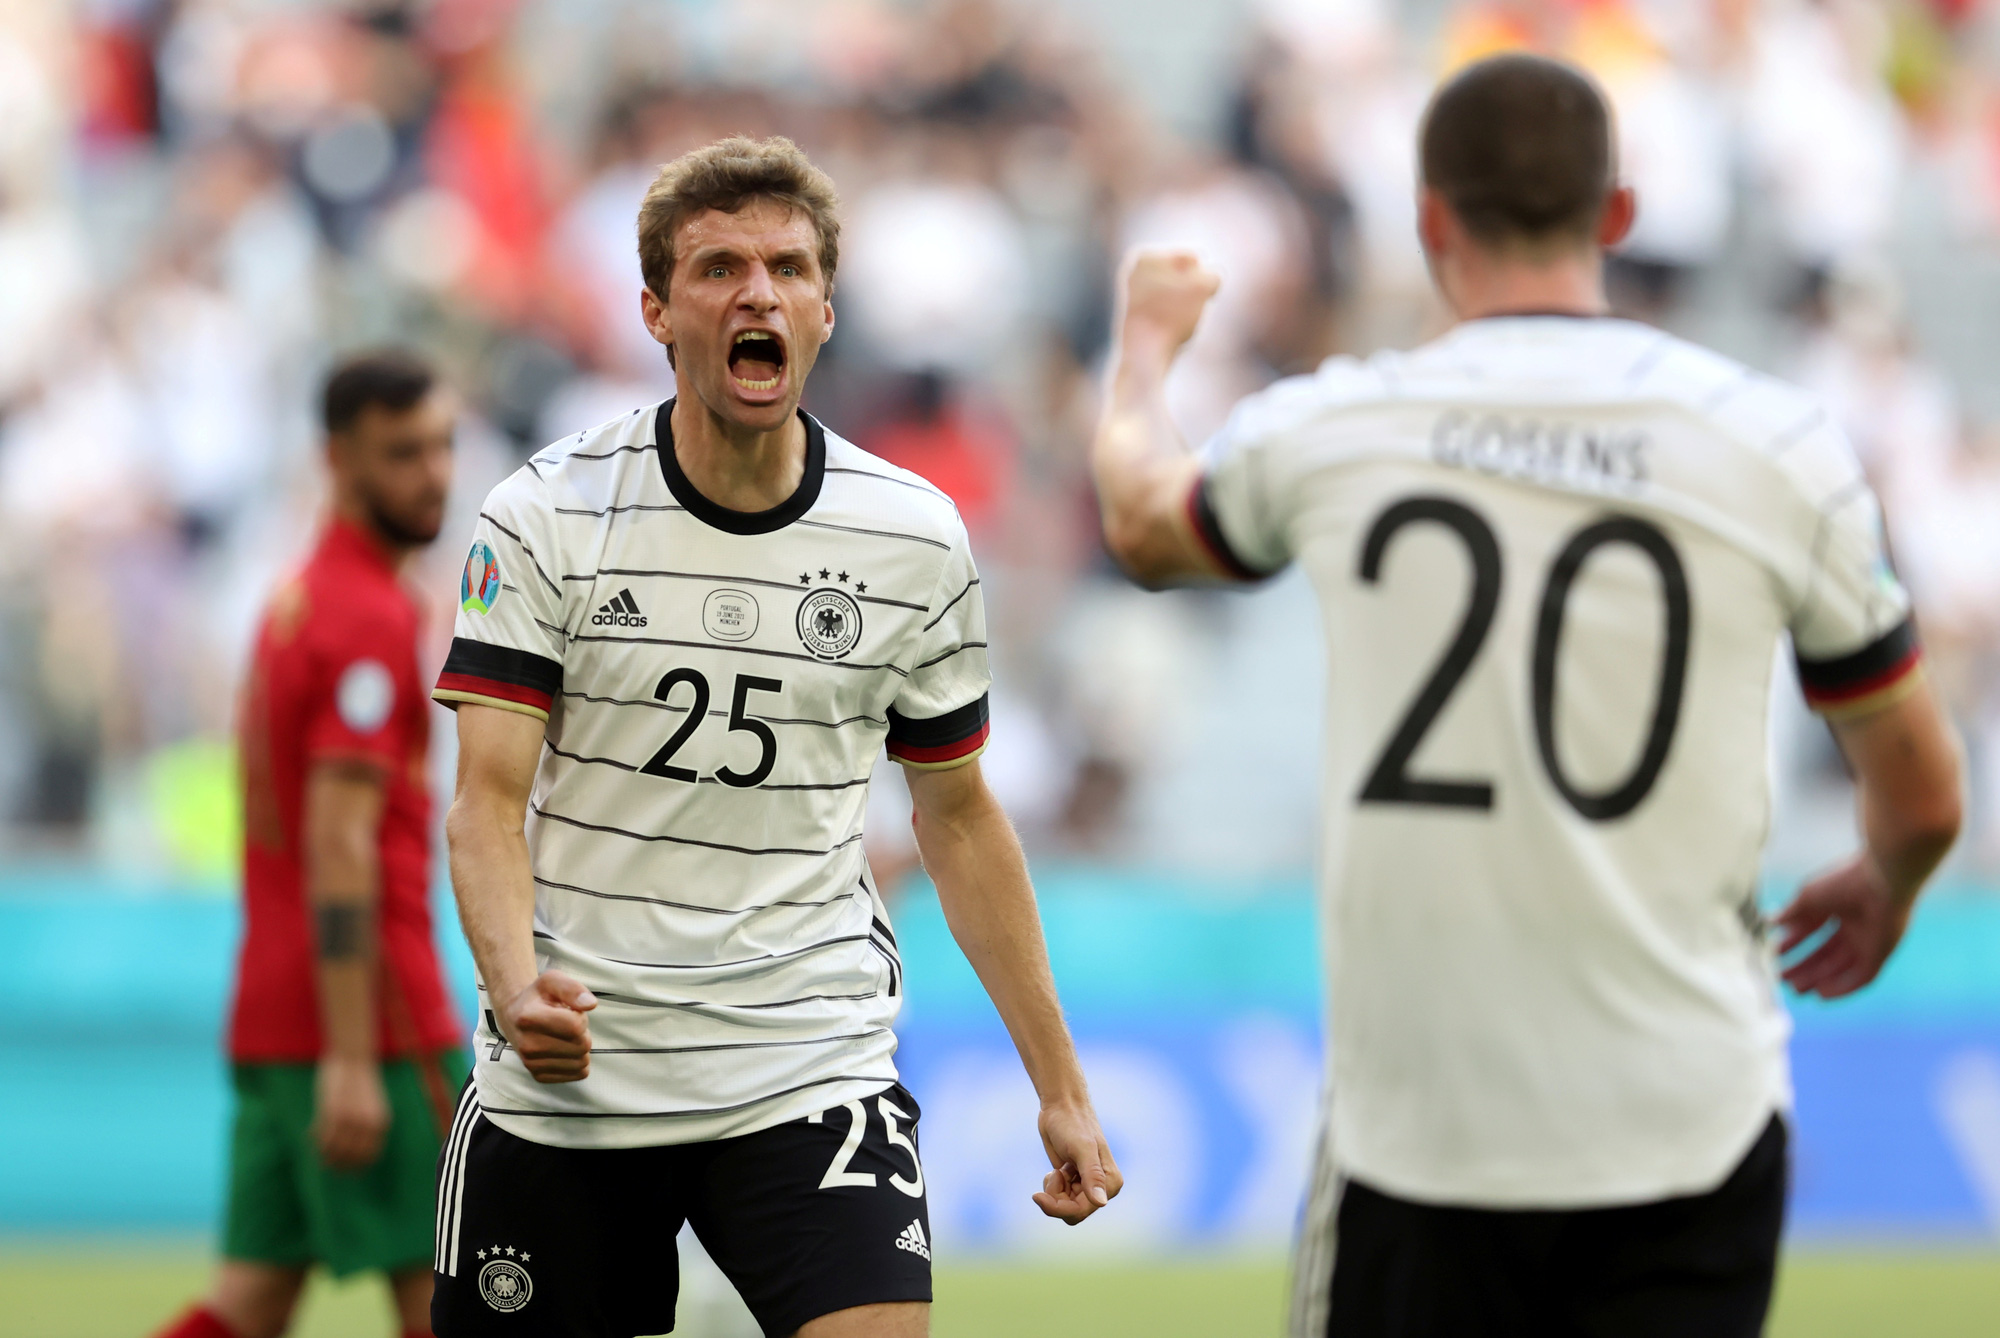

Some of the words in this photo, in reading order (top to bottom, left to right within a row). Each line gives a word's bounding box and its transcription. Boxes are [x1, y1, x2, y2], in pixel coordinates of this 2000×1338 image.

[1430, 411, 1654, 485] GOSENS
[591, 611, 648, 627] adidas
[720, 604, 742, 612] PORTUGAL
[811, 596, 850, 613] DEUTSCHER
[1355, 496, 1691, 825] 20
[638, 667, 783, 788] 25
[807, 1095, 924, 1199] 25
[488, 1266, 519, 1277] DEUTSCHER
